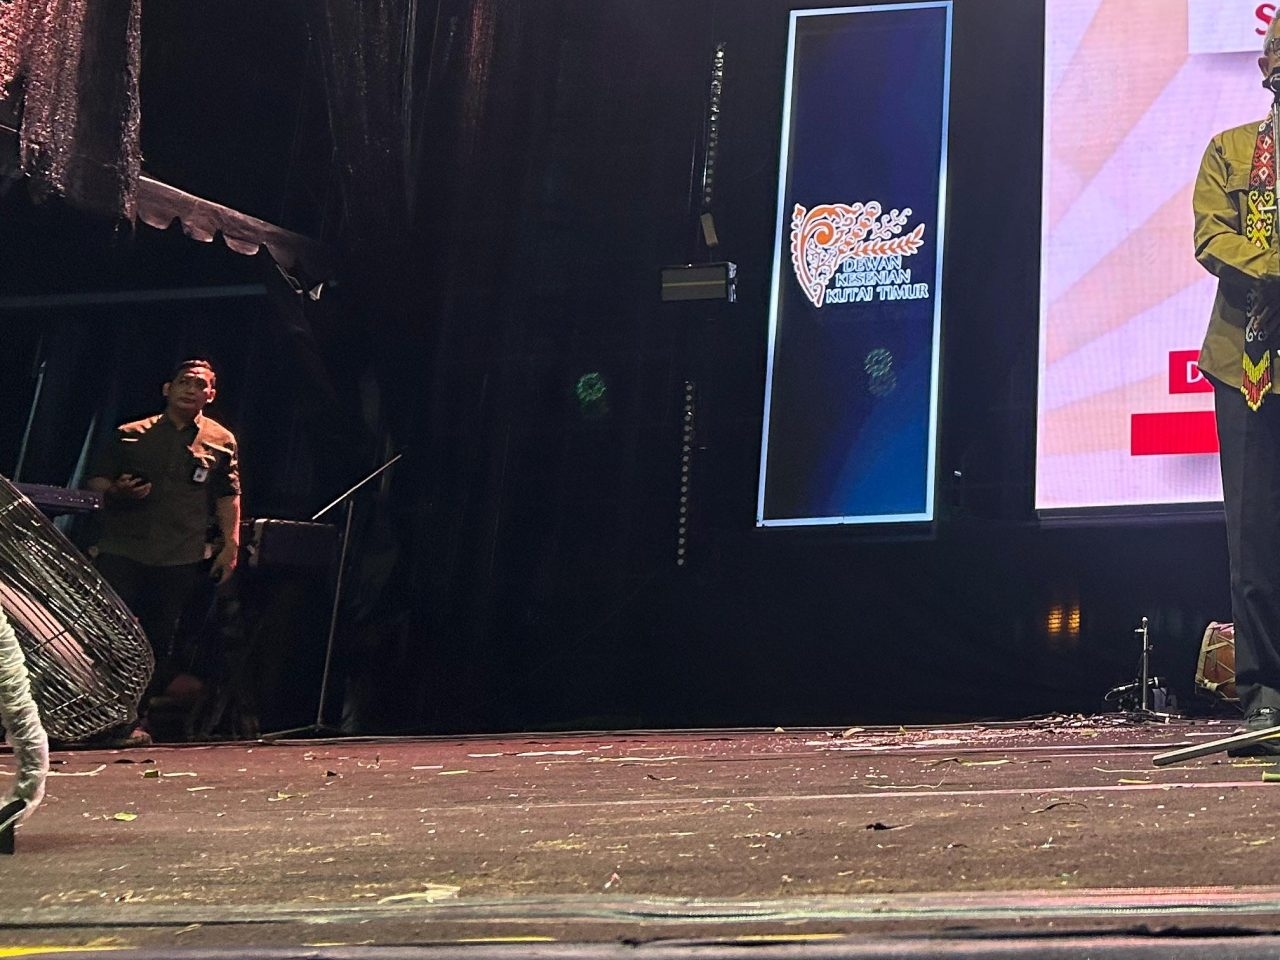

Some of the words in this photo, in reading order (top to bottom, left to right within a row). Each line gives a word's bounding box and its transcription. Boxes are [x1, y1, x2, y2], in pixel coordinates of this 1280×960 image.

[844, 256, 902, 272] DEWAN
[835, 269, 911, 287] KESENIAN
[825, 288, 873, 303] KUTAI
[876, 283, 929, 299] TIMUR
